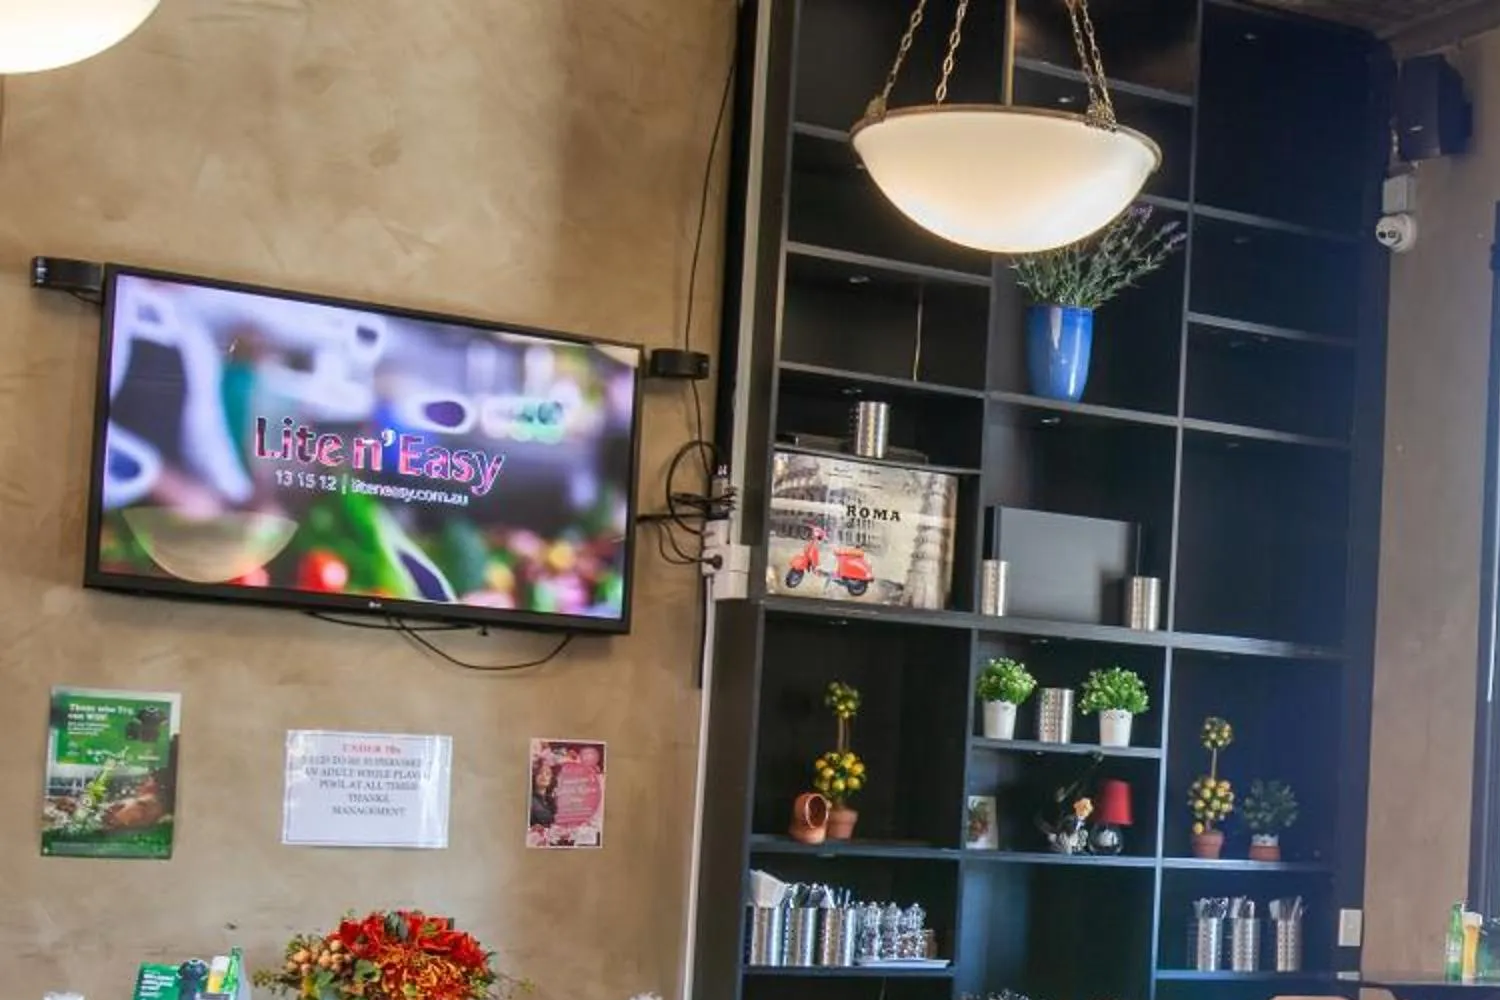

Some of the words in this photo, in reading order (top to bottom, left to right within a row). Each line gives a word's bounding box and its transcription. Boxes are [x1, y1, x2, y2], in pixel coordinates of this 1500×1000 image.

[254, 416, 345, 467] Lite
[398, 434, 505, 497] Easy
[319, 474, 337, 491] 12
[846, 504, 902, 523] ROMA
[365, 782, 383, 791] ALL
[331, 805, 407, 817] MANAGEMENT
